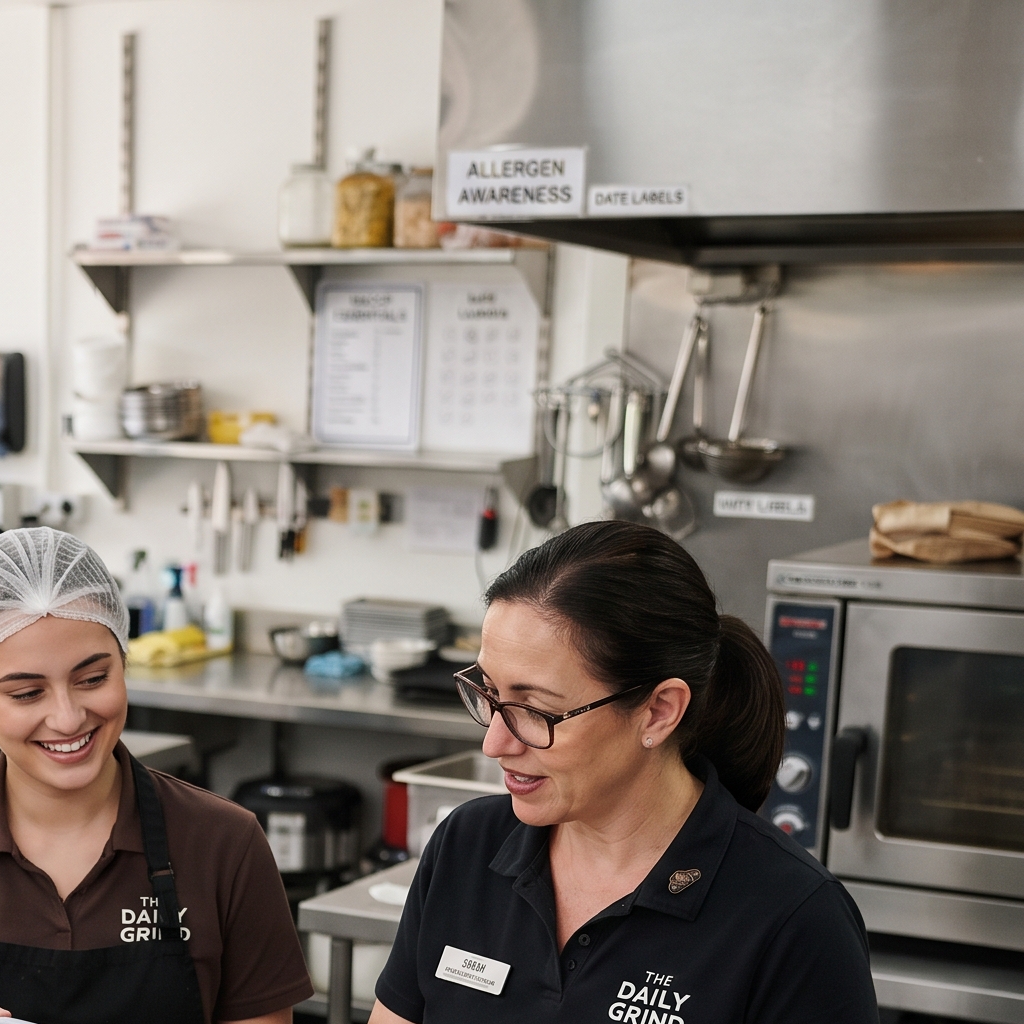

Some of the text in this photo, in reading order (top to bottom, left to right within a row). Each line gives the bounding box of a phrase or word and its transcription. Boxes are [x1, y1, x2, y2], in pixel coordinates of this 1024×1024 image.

[466, 159, 565, 179] ALLERGEN
[457, 184, 572, 205] AWARENESS
[594, 192, 628, 205] DATE
[139, 896, 159, 907] TH
[121, 907, 188, 925] DAIY
[120, 926, 191, 943] GRID
[645, 970, 674, 987] THE
[616, 980, 691, 1012] DAILY
